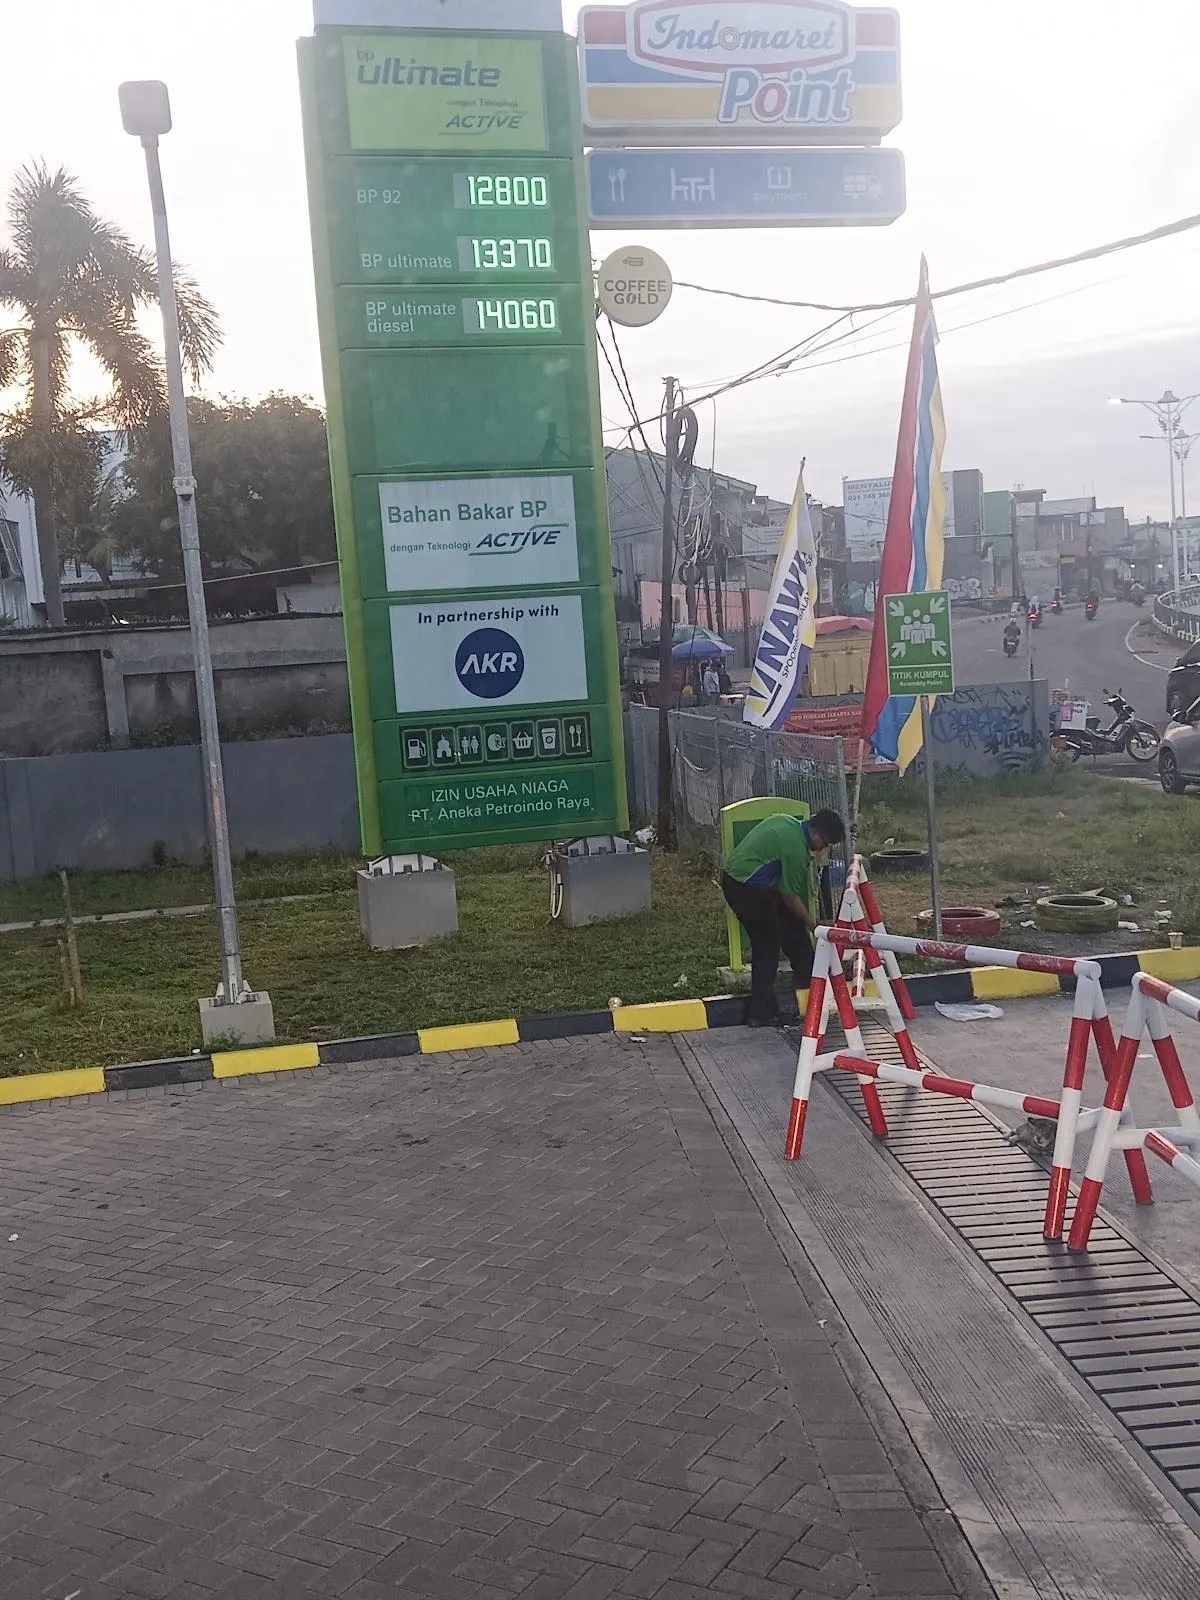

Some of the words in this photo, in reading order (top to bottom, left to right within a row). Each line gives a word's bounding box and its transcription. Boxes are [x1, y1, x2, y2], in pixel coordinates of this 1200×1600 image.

[646, 14, 836, 51] Indomaret
[356, 49, 375, 62] bp
[357, 57, 502, 87] ultimate
[718, 69, 854, 122] Point
[445, 114, 523, 130] ACTIVE
[357, 189, 378, 204] BP
[382, 189, 401, 204] 92
[467, 175, 547, 206] 12800
[361, 253, 383, 269] BP
[387, 253, 453, 269] ultimate
[471, 238, 551, 268] 13370
[604, 280, 667, 292] COFFEE
[365, 301, 387, 316] BP
[392, 301, 456, 316] ultimate
[614, 292, 659, 305] GOLD
[367, 318, 415, 333] diesel
[476, 299, 556, 330] 14060
[387, 505, 451, 524] Bahan
[457, 502, 515, 521] Bakar
[520, 500, 547, 518] BP
[390, 543, 424, 554] dengan
[427, 541, 471, 552] Teknologi
[476, 530, 561, 548] ACTIVE
[418, 612, 432, 624] In
[436, 607, 524, 626] partnership
[528, 604, 559, 617] with
[460, 652, 518, 675] AKR
[892, 671, 912, 680] TITIK
[914, 670, 950, 679] KUMPUL
[431, 788, 460, 803] IZIN
[464, 783, 518, 801] USAHA
[521, 779, 569, 795] NIAGA
[410, 808, 434, 822] PT.
[438, 805, 482, 820] Aneka
[486, 800, 553, 816] Petroindo
[557, 797, 590, 811] Raya
